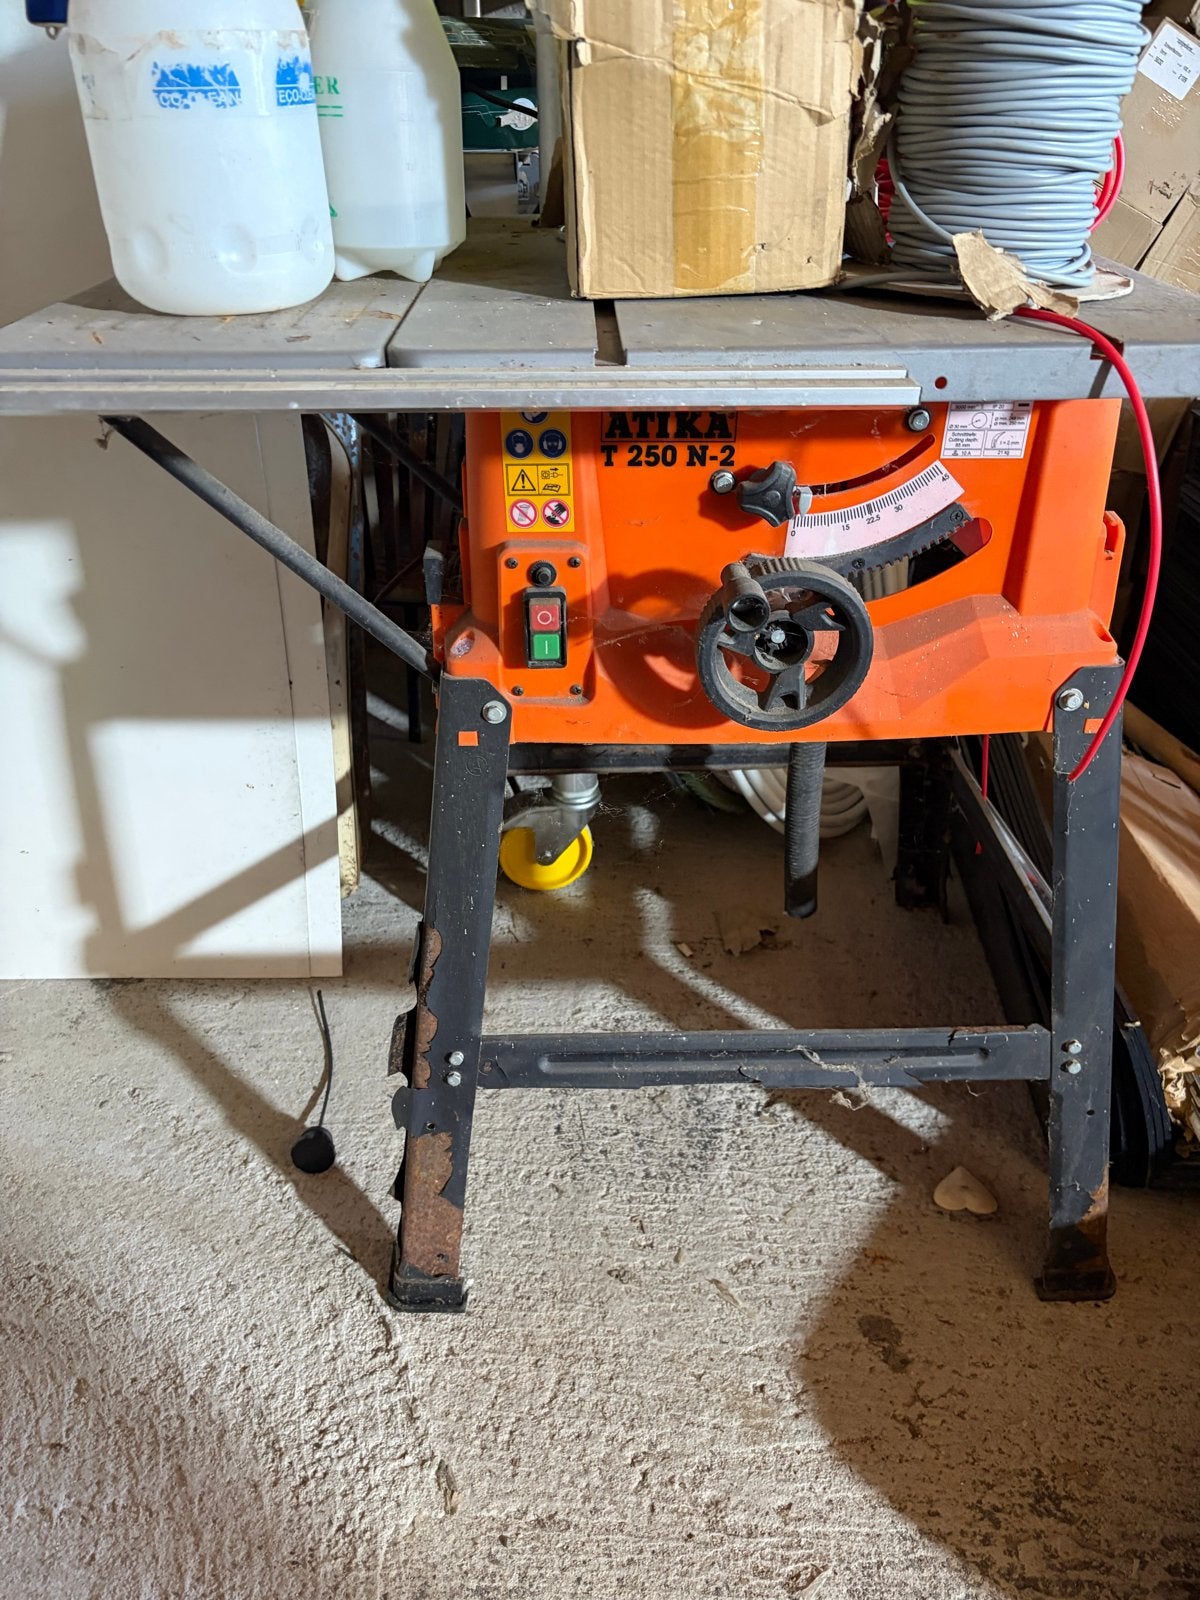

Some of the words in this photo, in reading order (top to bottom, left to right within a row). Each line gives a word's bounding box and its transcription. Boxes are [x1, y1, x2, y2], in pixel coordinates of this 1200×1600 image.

[314, 76, 339, 94] ER
[605, 411, 733, 438] ATIKA
[600, 445, 618, 466] T
[627, 444, 678, 467] 250
[686, 445, 736, 466] N-2
[866, 515, 881, 525] 22.5
[894, 504, 903, 513] 30
[941, 473, 950, 482] 45
